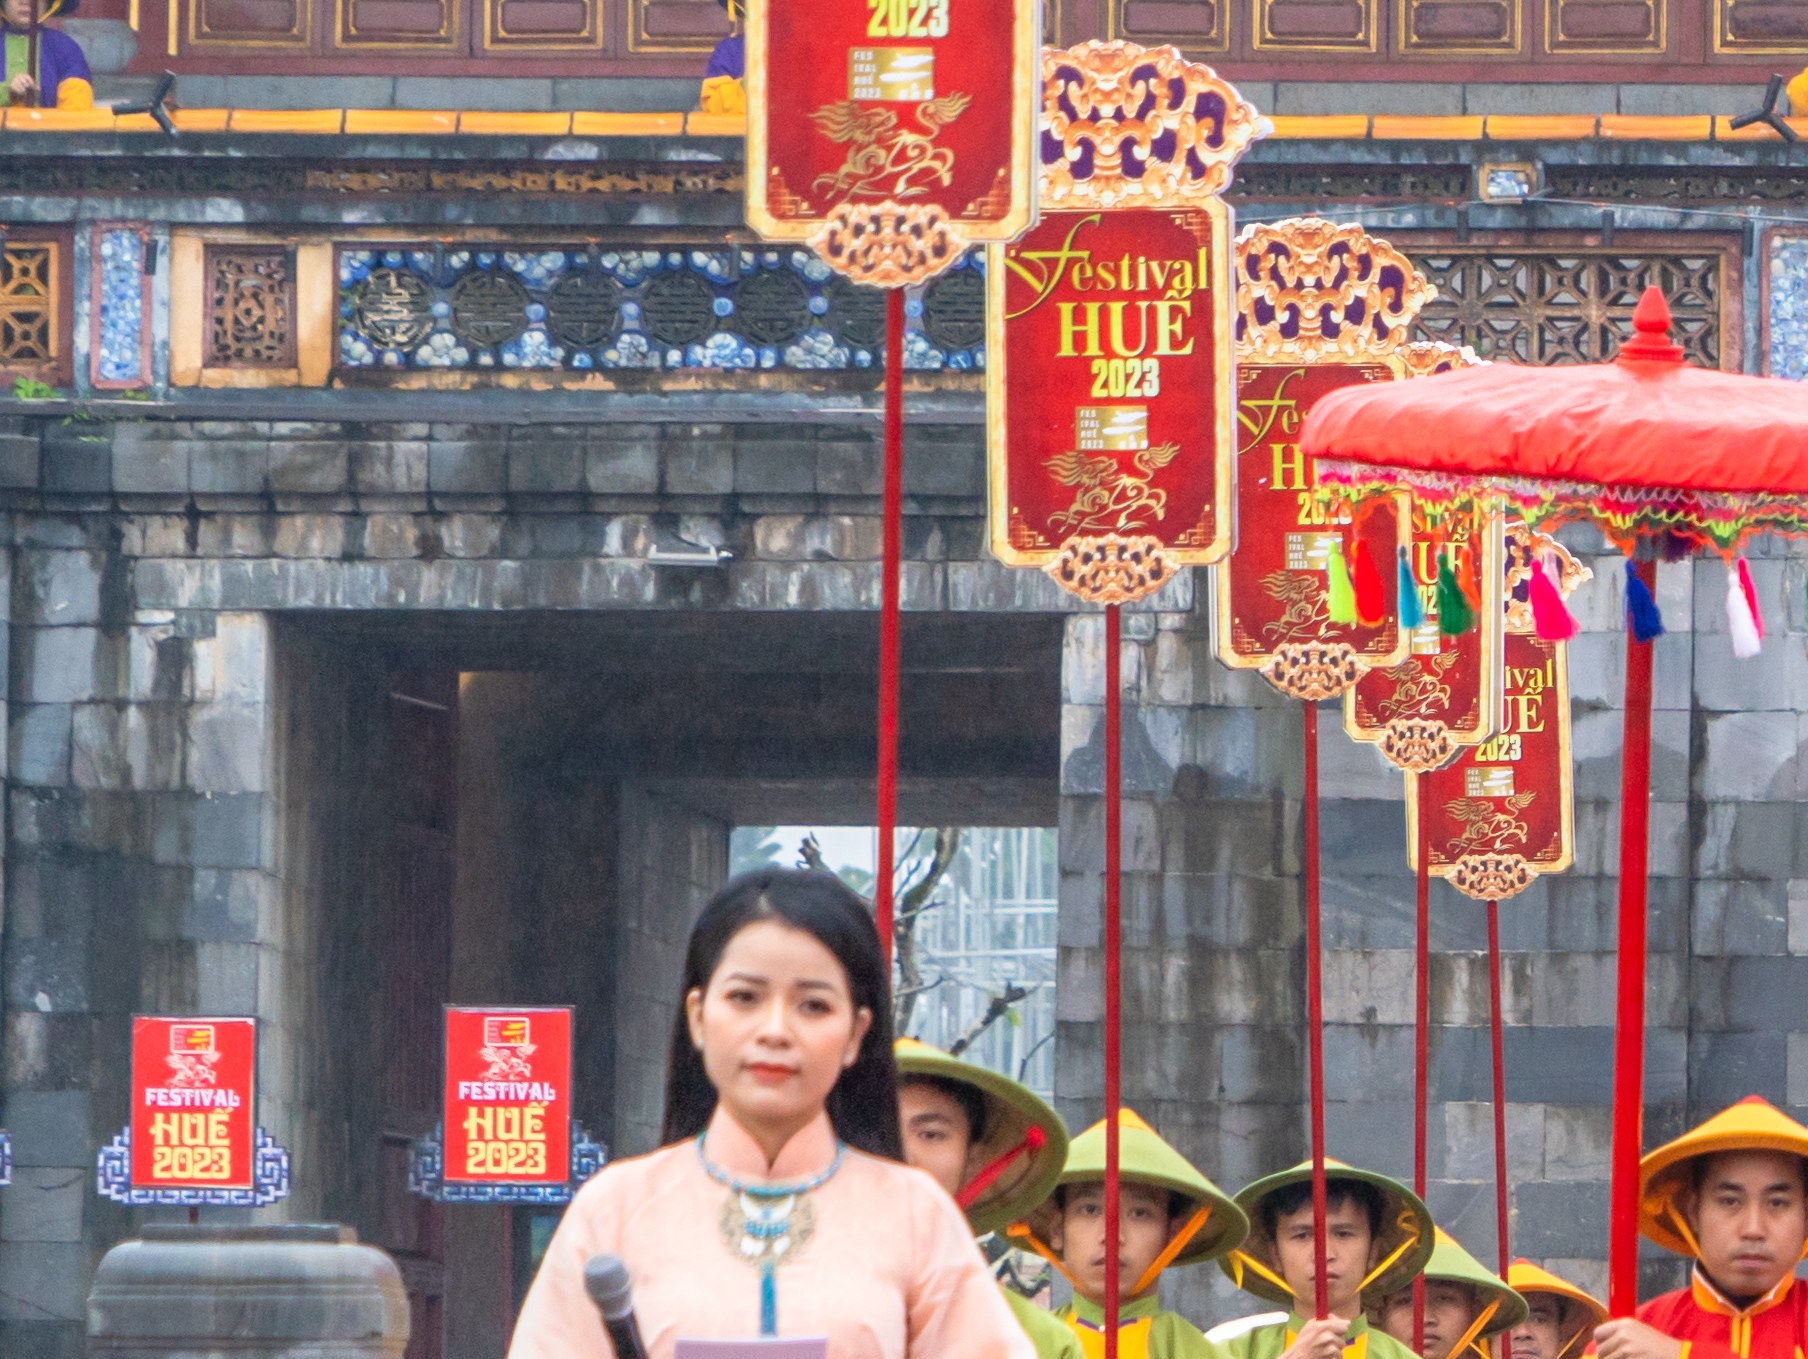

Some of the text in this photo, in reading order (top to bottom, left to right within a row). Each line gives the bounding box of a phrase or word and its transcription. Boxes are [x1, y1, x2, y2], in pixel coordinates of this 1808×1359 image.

[867, 0, 949, 37] 2023
[1004, 214, 1209, 319] Festival
[1056, 288, 1194, 357] HUẾ
[1091, 358, 1160, 397] 2023
[145, 1088, 241, 1108] FESTIVAL
[458, 1081, 556, 1101] FESTIVAL
[149, 1107, 234, 1146] HUẾ
[463, 1101, 549, 1141] HUẾ
[153, 1146, 231, 1180] 2023
[466, 1141, 547, 1175] 2023
